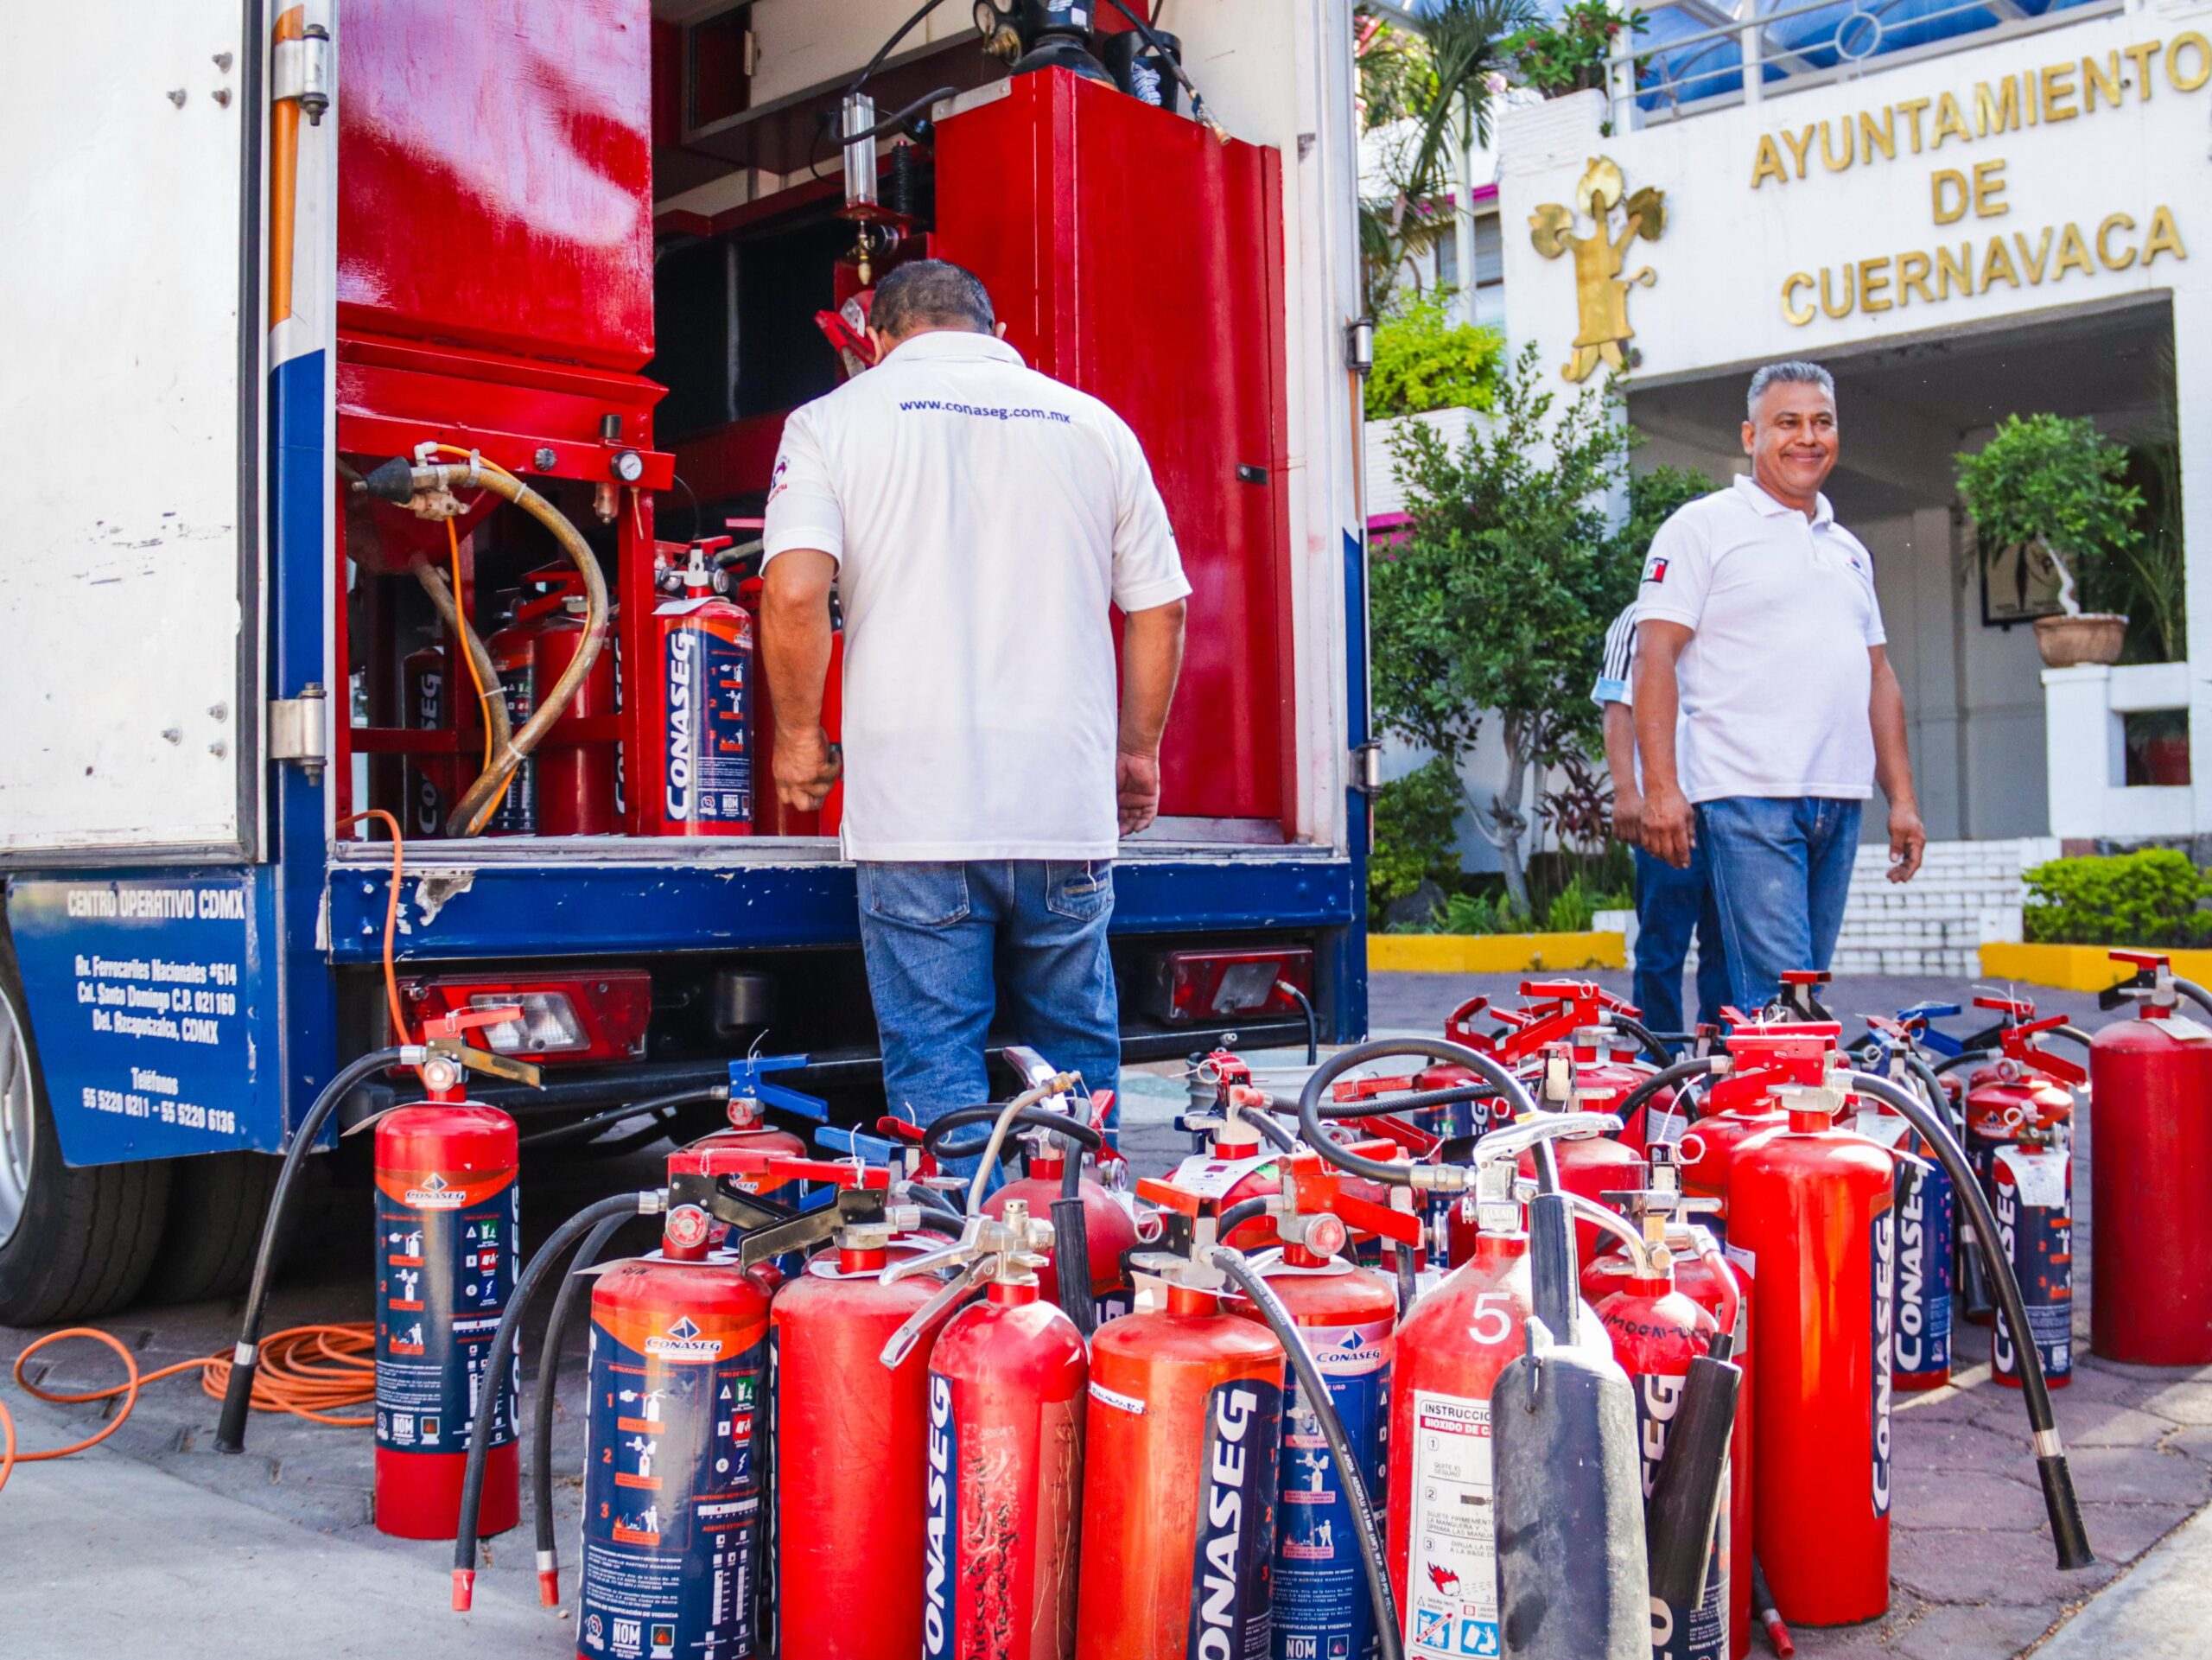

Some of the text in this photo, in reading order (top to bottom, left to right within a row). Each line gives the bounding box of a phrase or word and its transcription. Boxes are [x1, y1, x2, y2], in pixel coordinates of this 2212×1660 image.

[1751, 30, 2212, 188] AYUNTAMIENTO
[1930, 158, 2009, 226] DE
[1781, 203, 2188, 328] CUERNAVACA
[899, 400, 1071, 423] www.conaseg.com.mx
[666, 633, 696, 820] CONASEG
[67, 889, 245, 919] CENTRO OPERATIVO CDMX
[75, 954, 91, 976] Av.
[151, 958, 207, 983] Nacionales
[209, 963, 237, 986] #614
[77, 981, 96, 1003] Col.
[97, 982, 126, 1006] Santo
[127, 985, 170, 1014] Domingo
[172, 988, 193, 1012] C.P.
[92, 1008, 219, 1045] Del. Azcapotzalco, CDMX
[130, 1066, 179, 1096] Teléfonos
[82, 1087, 97, 1109] 55
[98, 1090, 124, 1113] 5220
[125, 1094, 149, 1118] 0211
[161, 1100, 175, 1123] 55
[177, 1103, 206, 1129] 5220
[406, 1190, 465, 1202] CONASEG
[1895, 1162, 1928, 1372] CONASEG
[1468, 1292, 1512, 1345] 5
[645, 1337, 722, 1353] CONASEG
[1316, 1350, 1380, 1363] CONASEG
[1872, 1217, 1893, 1511] CONASEG
[607, 1393, 613, 1409] 1
[1425, 1403, 1491, 1421] INSTRUCCIO
[393, 1418, 414, 1433] NOM
[1424, 1418, 1463, 1433] BIOXIDO
[1465, 1424, 1479, 1434] DE
[603, 1448, 613, 1464] 2
[1343, 1452, 1356, 1474] ARDA
[1350, 1474, 1368, 1509] AEROFLU
[1434, 1468, 1460, 1478] SEGURO
[1427, 1489, 1434, 1498] 2
[601, 1502, 609, 1518] 3
[922, 1376, 950, 1660] ONASEG
[1265, 1507, 1272, 1522] 2
[1427, 1511, 1449, 1521] SUJETE
[1198, 1389, 1258, 1660] ONASEG
[1427, 1523, 1451, 1534] OPRIMA
[1467, 1530, 1494, 1538] MANIJA
[1436, 1520, 1472, 1530] MANGUERA
[1427, 1540, 1433, 1549] 3
[1452, 1541, 1472, 1549] DIRIJA
[1262, 1566, 1268, 1580] 3
[613, 1623, 641, 1644] NOM
[1287, 1639, 1316, 1660] NOM
